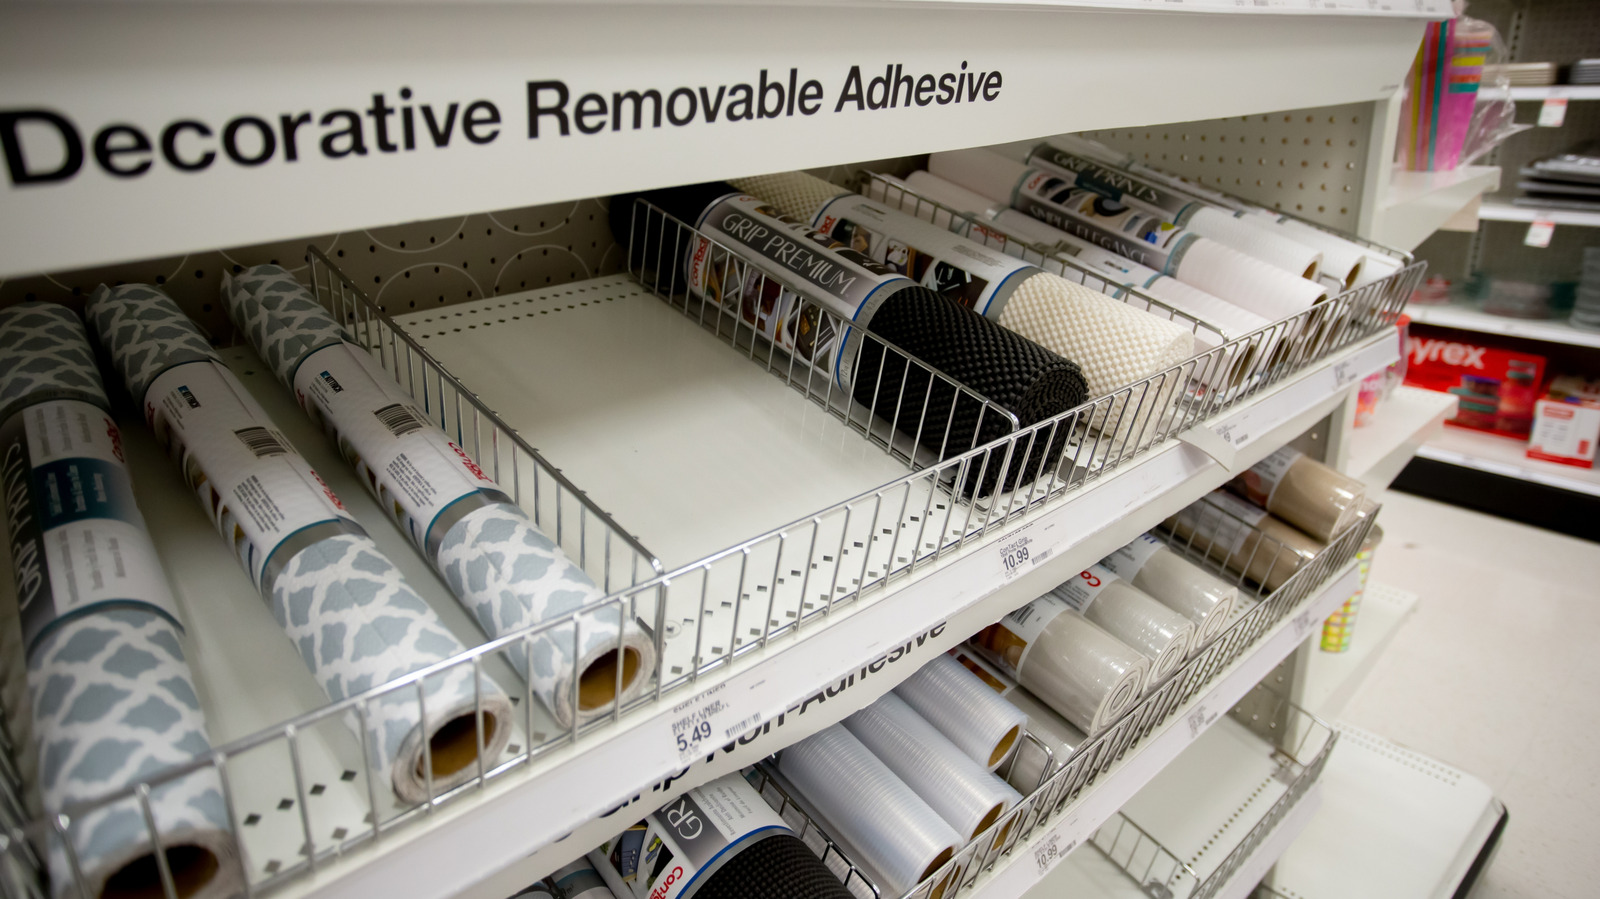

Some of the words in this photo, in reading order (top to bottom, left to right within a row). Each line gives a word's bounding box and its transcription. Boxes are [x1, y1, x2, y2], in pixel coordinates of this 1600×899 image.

[0, 86, 502, 188] Decorative
[526, 67, 824, 140] Removable
[834, 60, 1003, 114] Adhesive
[721, 212, 770, 243] GRIP
[762, 235, 857, 297] PREMIUM
[1002, 546, 1030, 571] 10.99
[676, 720, 712, 752] 5.49
[660, 794, 704, 840] GRI
[1036, 843, 1058, 869] 10.99
